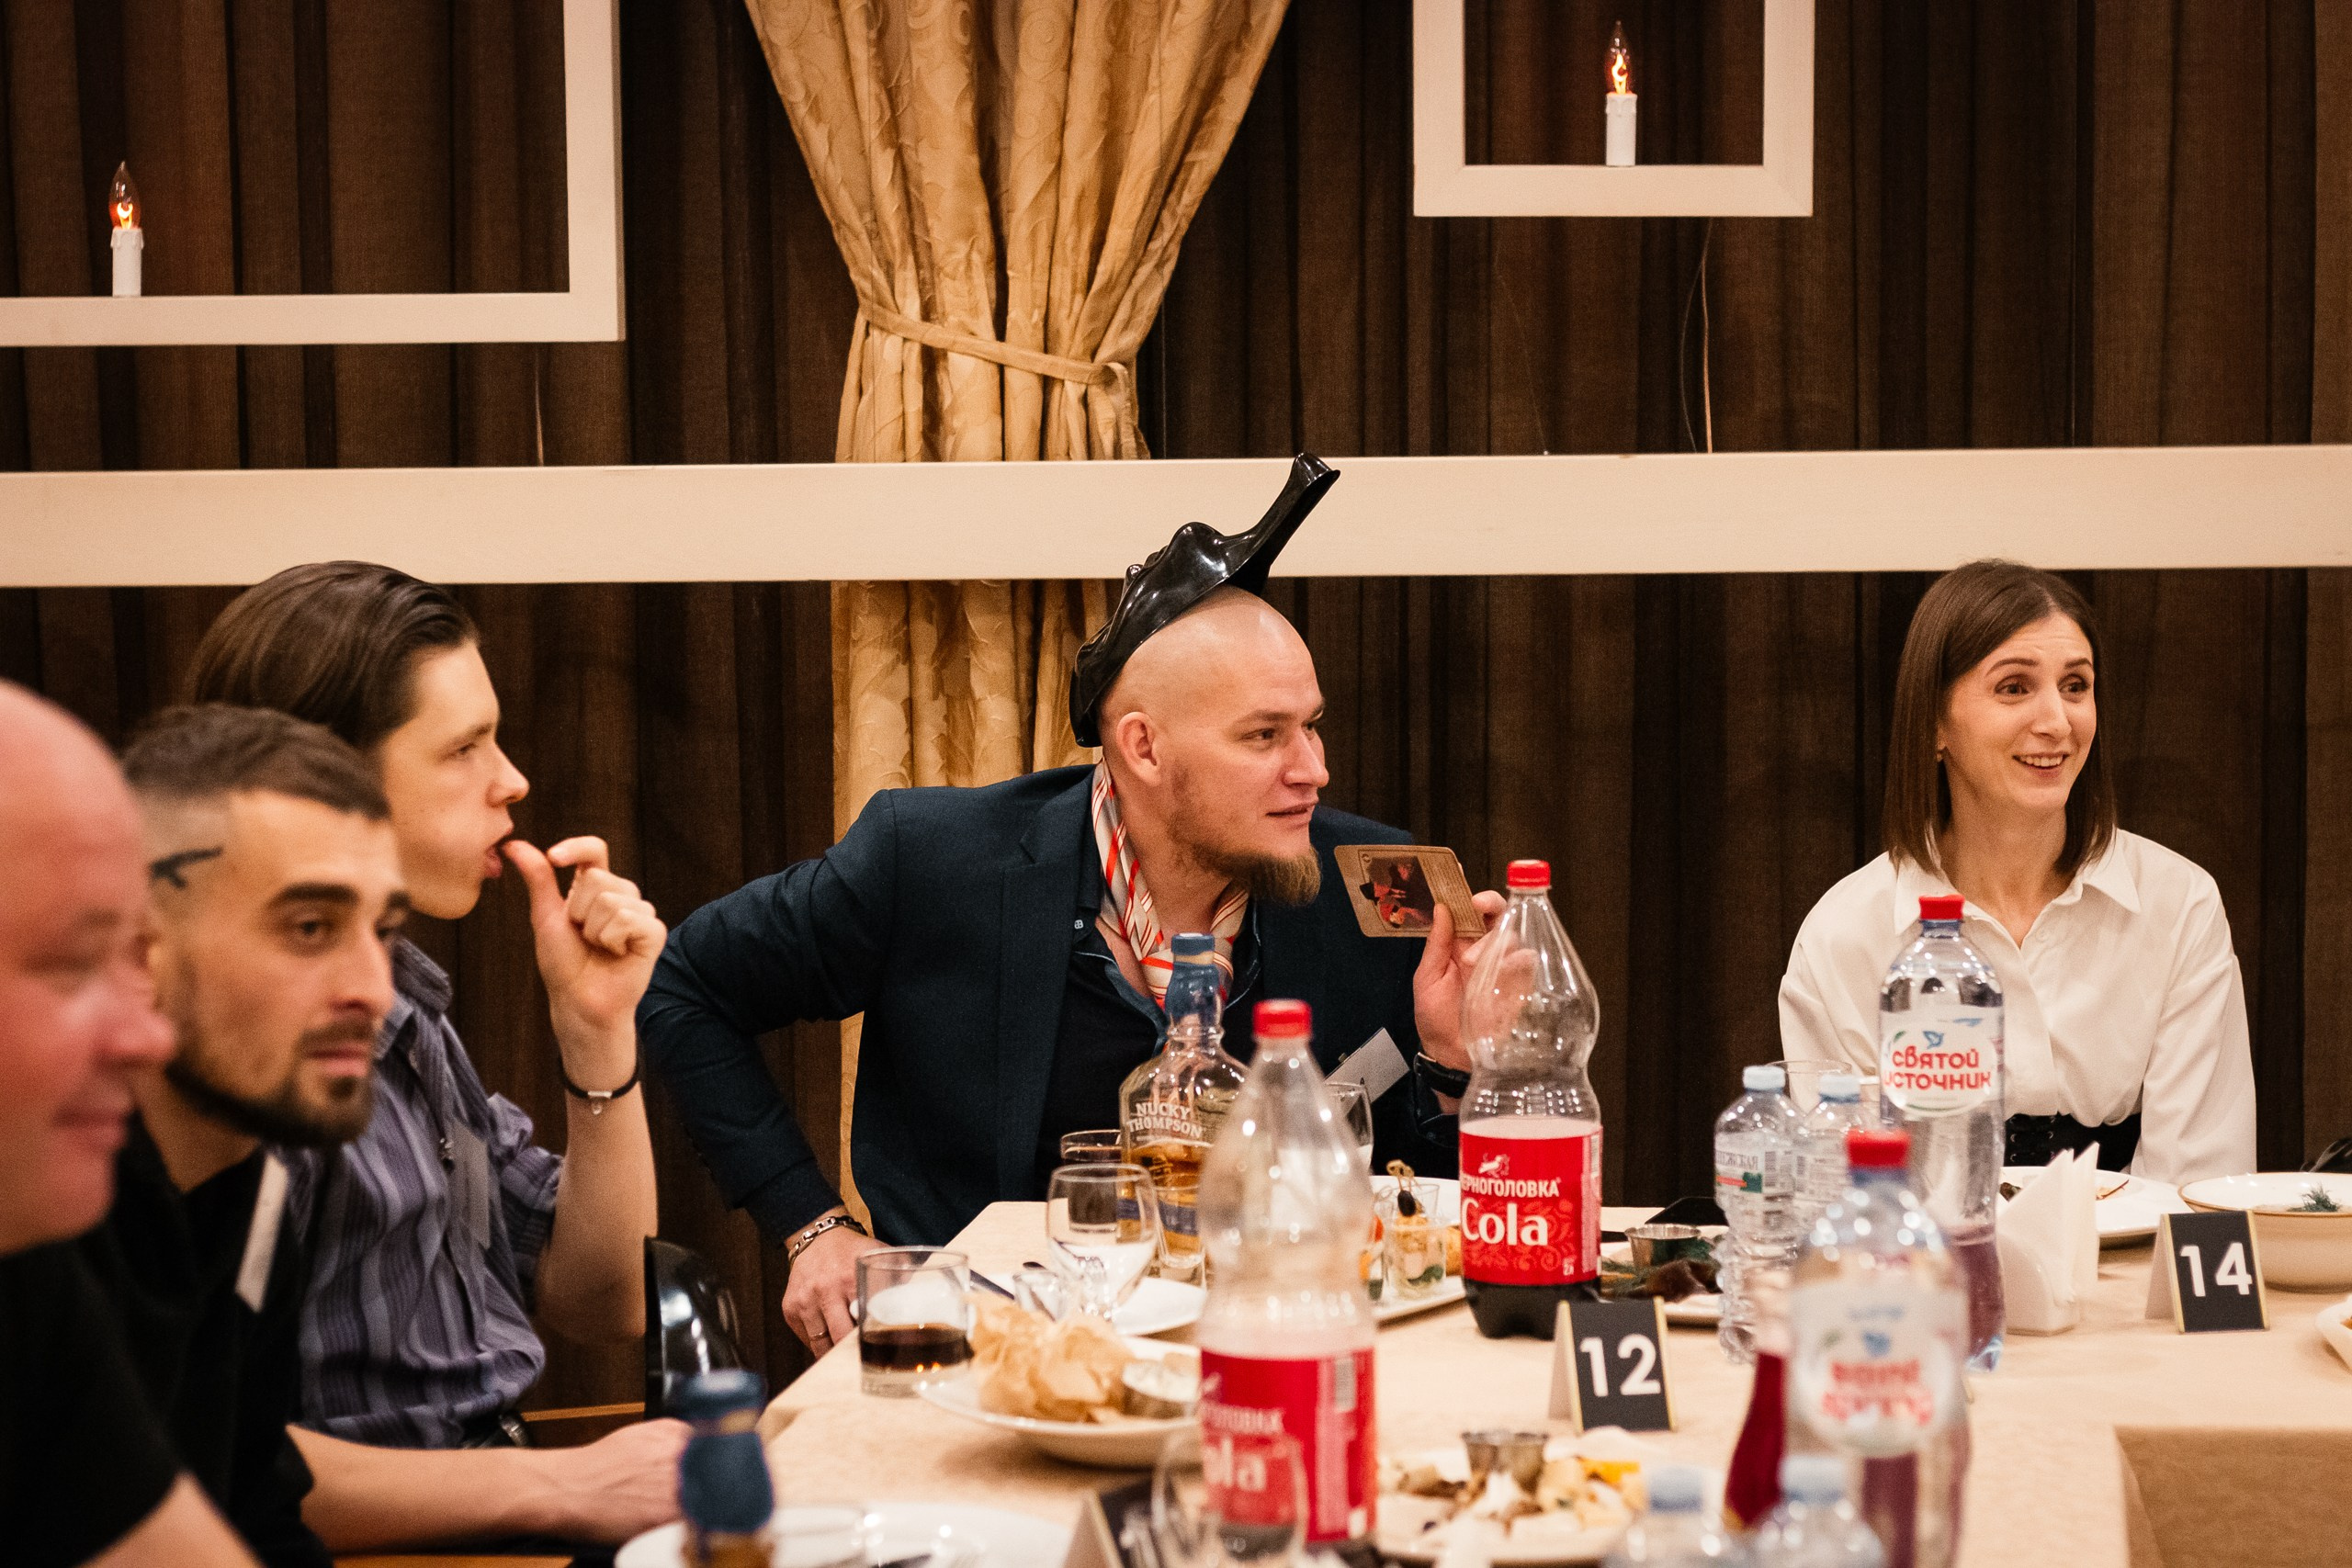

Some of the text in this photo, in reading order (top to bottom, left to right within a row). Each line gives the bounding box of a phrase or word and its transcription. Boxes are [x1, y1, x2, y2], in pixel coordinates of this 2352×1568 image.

[1125, 1116, 1203, 1138] THOMPSON
[1135, 1102, 1192, 1120] NUCKY
[1462, 1197, 1548, 1247] Cola
[2179, 1241, 2253, 1298] 14
[1579, 1332, 1661, 1397] 12
